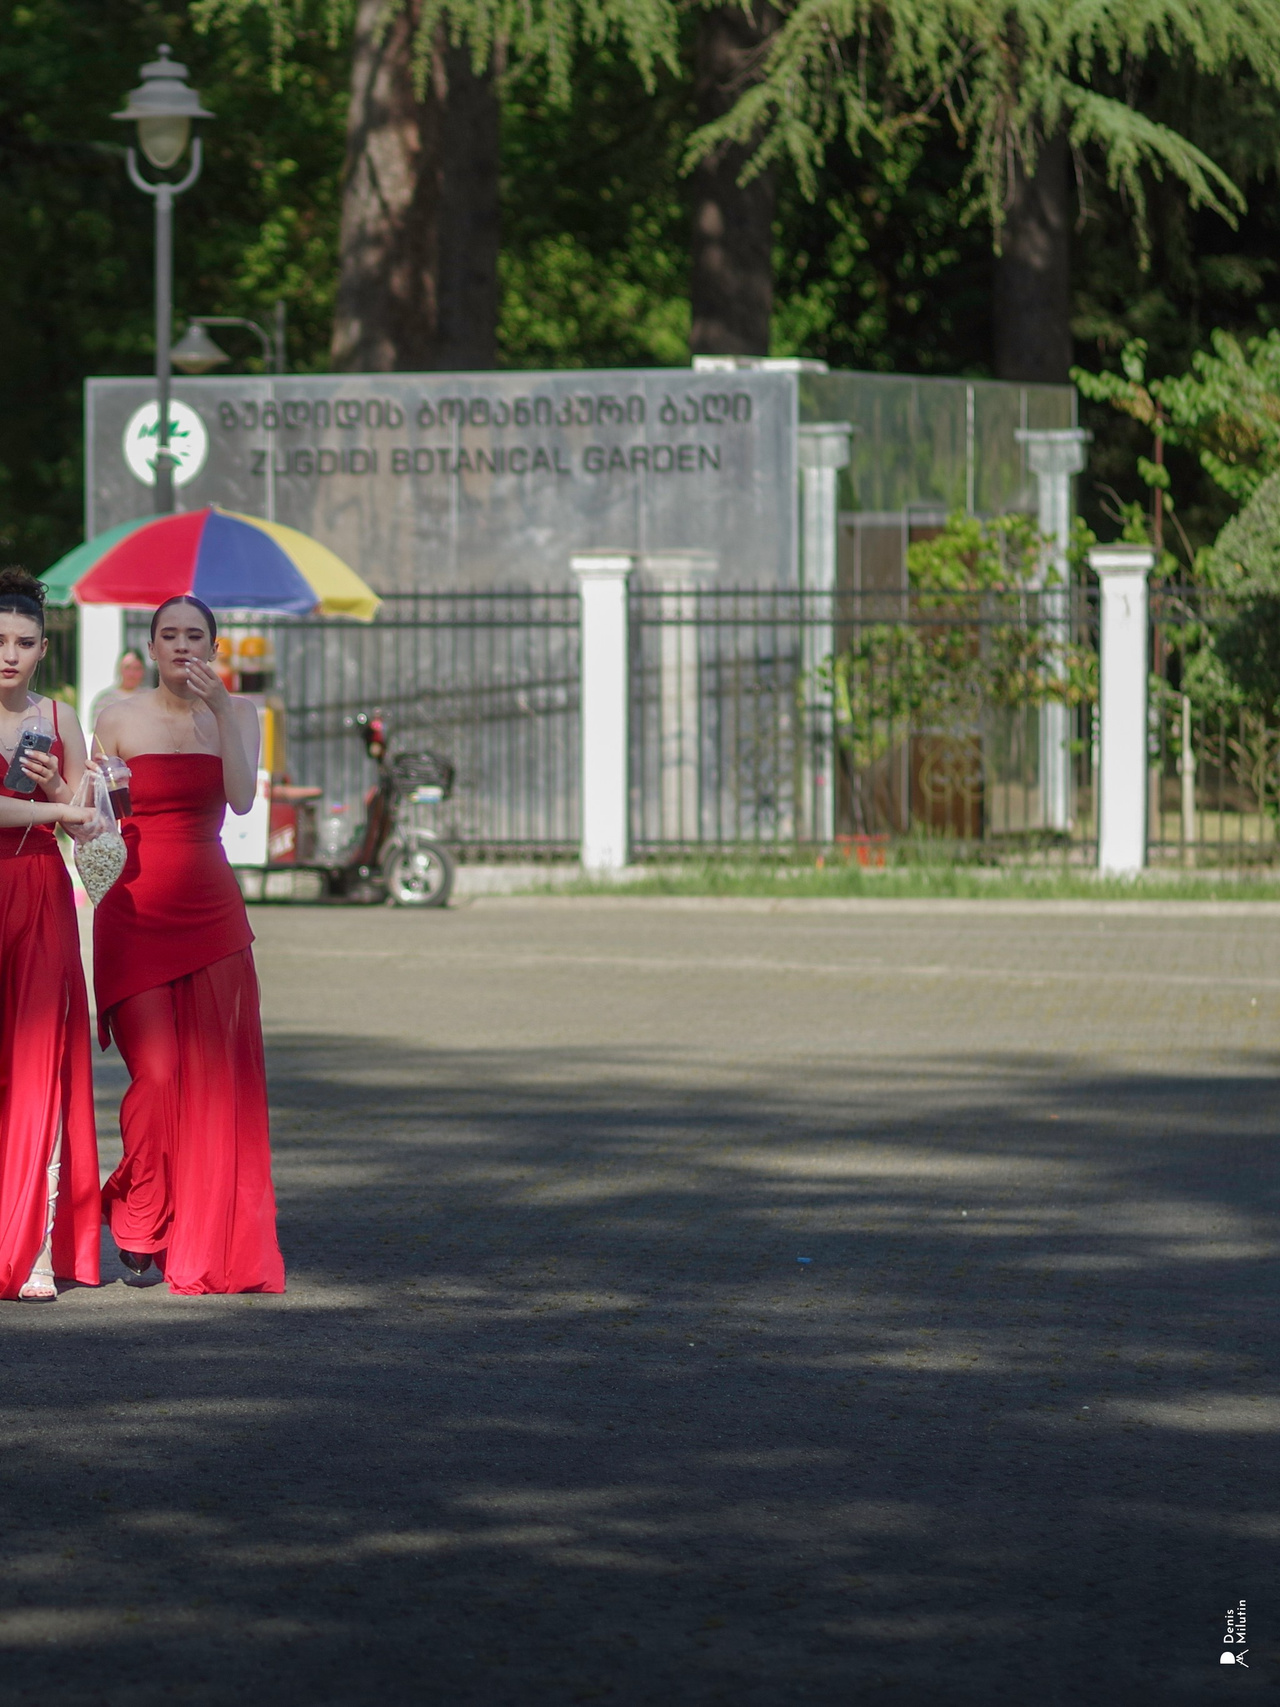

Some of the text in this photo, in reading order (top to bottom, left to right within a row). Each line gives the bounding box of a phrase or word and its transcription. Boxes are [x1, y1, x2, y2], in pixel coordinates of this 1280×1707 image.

[660, 392, 752, 425] ბაღი
[250, 445, 721, 476] ZUGDIDI BOTANICAL GARDEN
